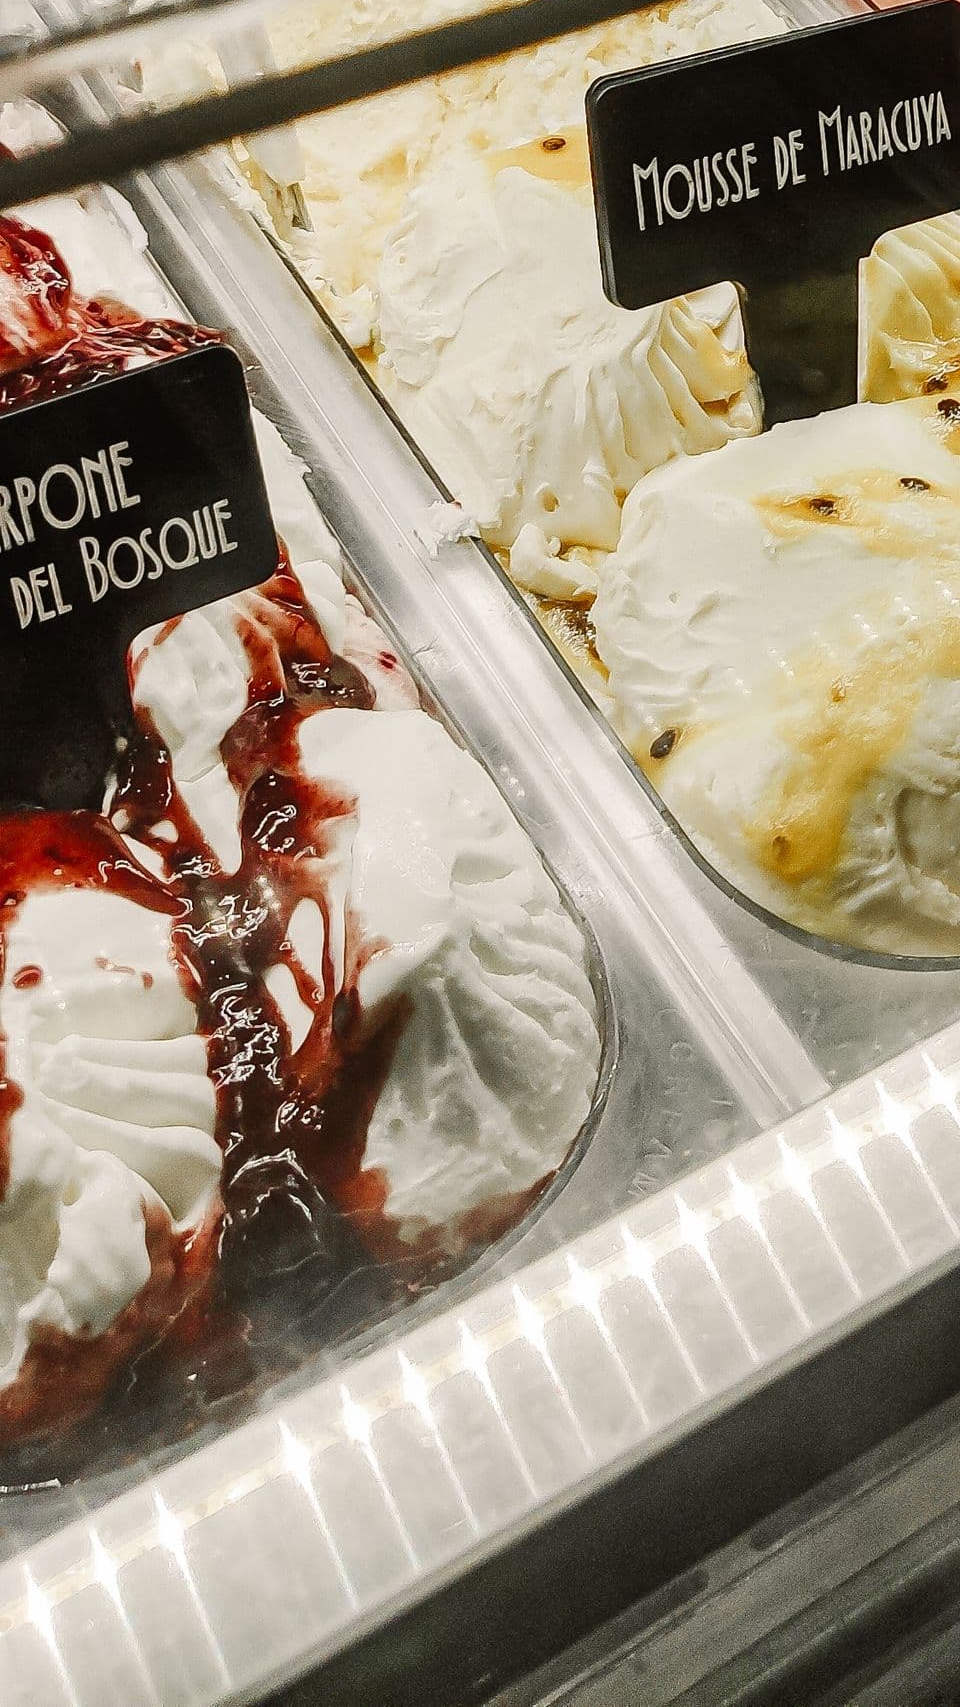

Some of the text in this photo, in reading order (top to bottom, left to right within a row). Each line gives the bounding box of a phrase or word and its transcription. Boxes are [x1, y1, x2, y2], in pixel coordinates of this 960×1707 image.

[632, 91, 952, 231] MOUSSE DE MARACUYA
[0, 441, 141, 553] RPONE
[10, 498, 239, 630] DEL BOSQUE
